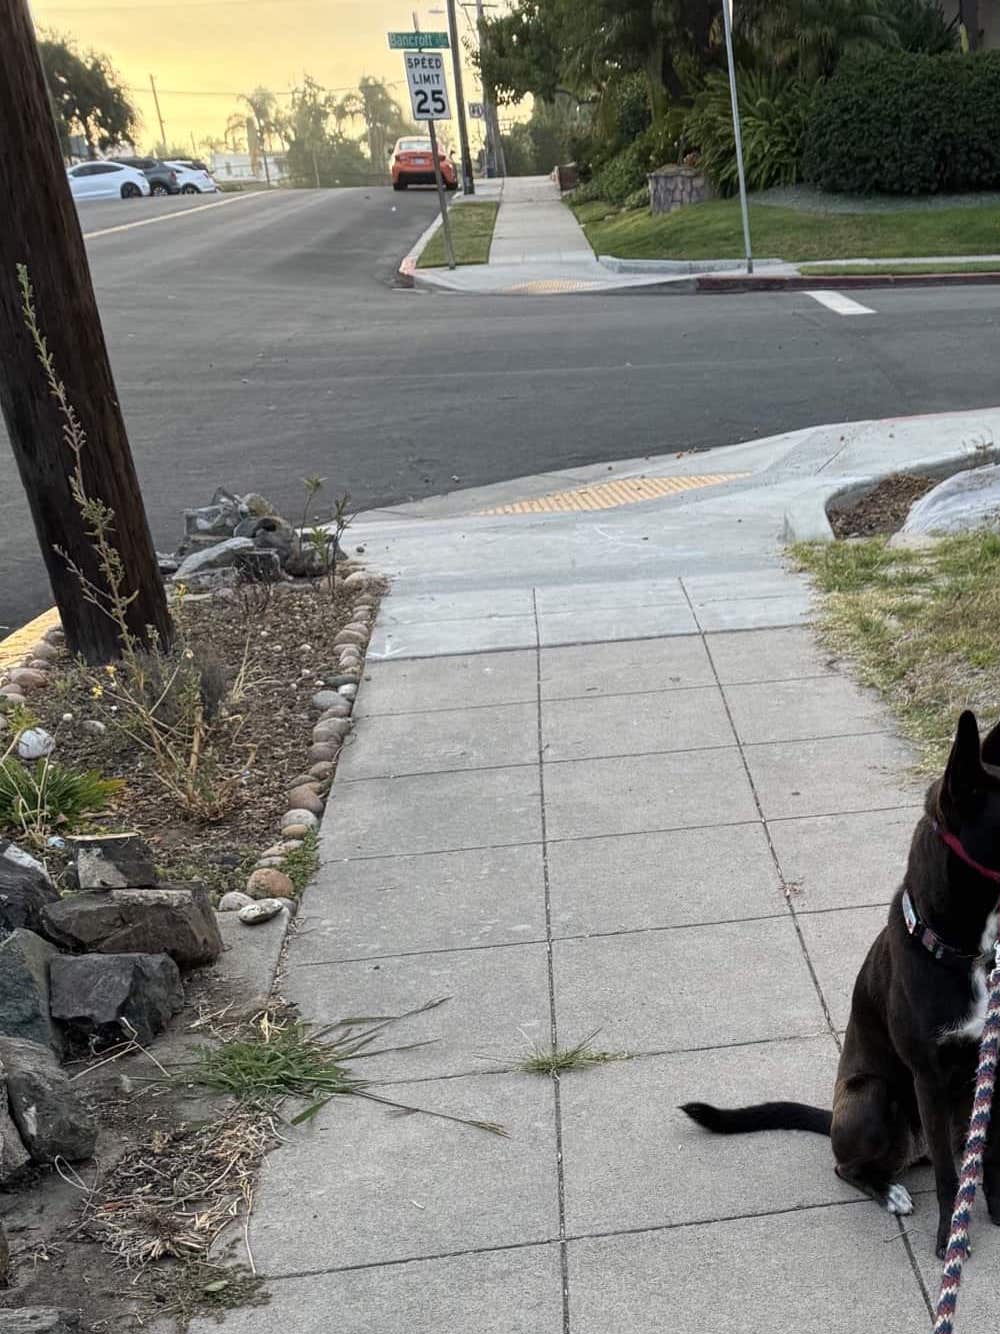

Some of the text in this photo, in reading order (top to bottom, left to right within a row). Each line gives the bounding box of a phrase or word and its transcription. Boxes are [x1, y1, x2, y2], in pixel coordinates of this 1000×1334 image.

[407, 57, 442, 69] SPEED
[412, 74, 441, 85] LIMIT
[414, 89, 446, 114] 25
